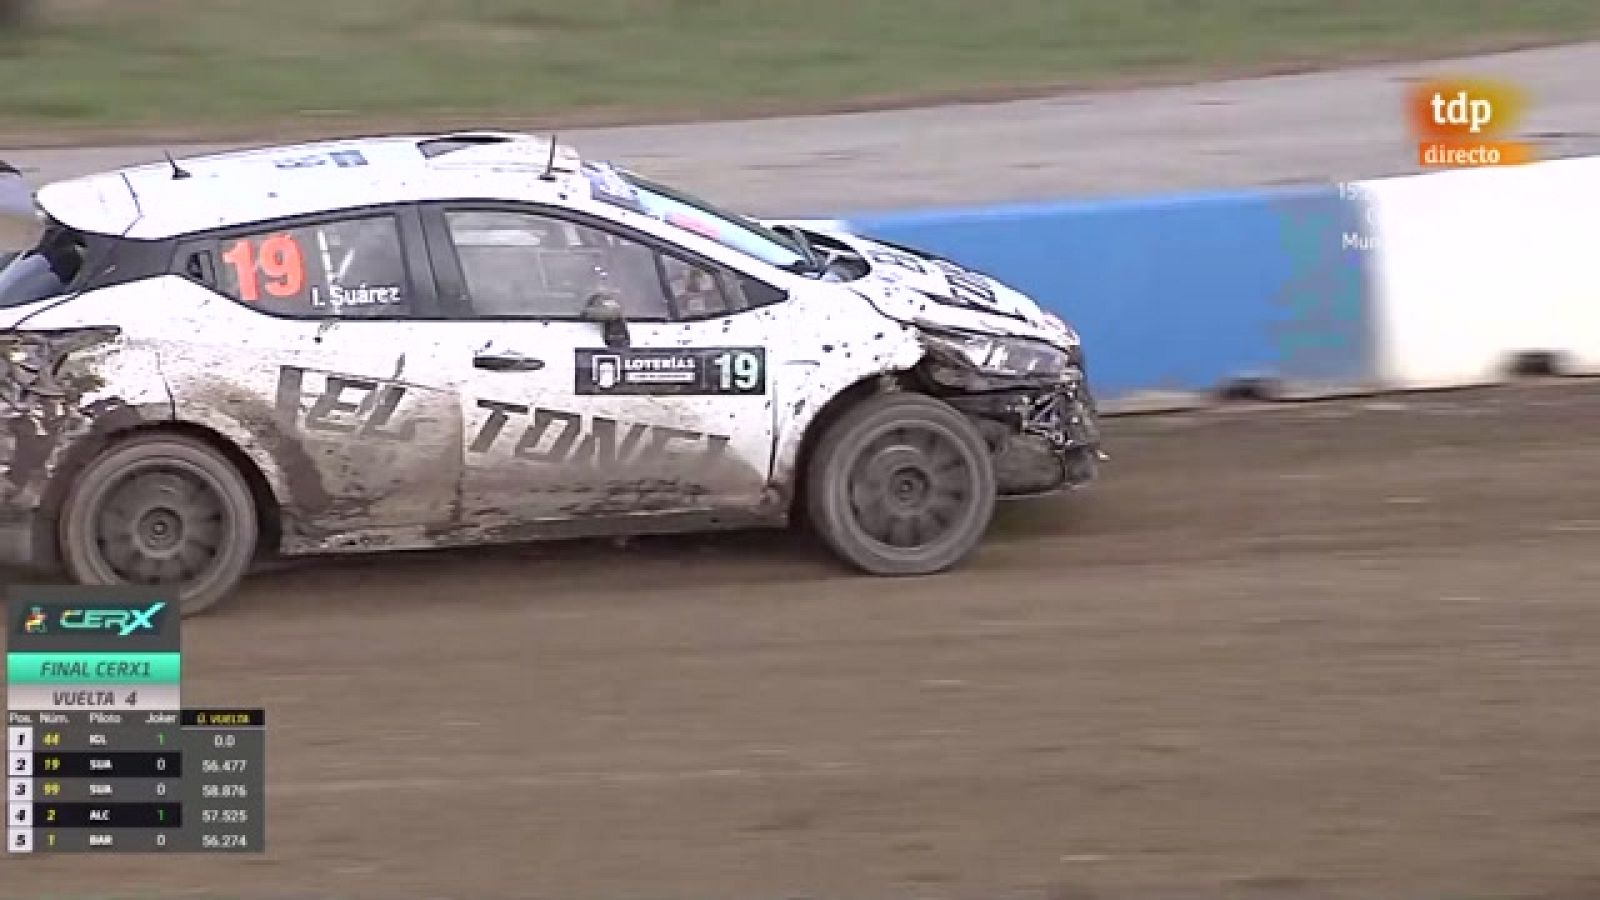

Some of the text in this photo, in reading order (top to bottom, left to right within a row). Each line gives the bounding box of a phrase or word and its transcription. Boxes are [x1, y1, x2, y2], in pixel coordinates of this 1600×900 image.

[222, 233, 304, 301] 19
[329, 280, 400, 306] Suárez
[714, 353, 759, 389] 19
